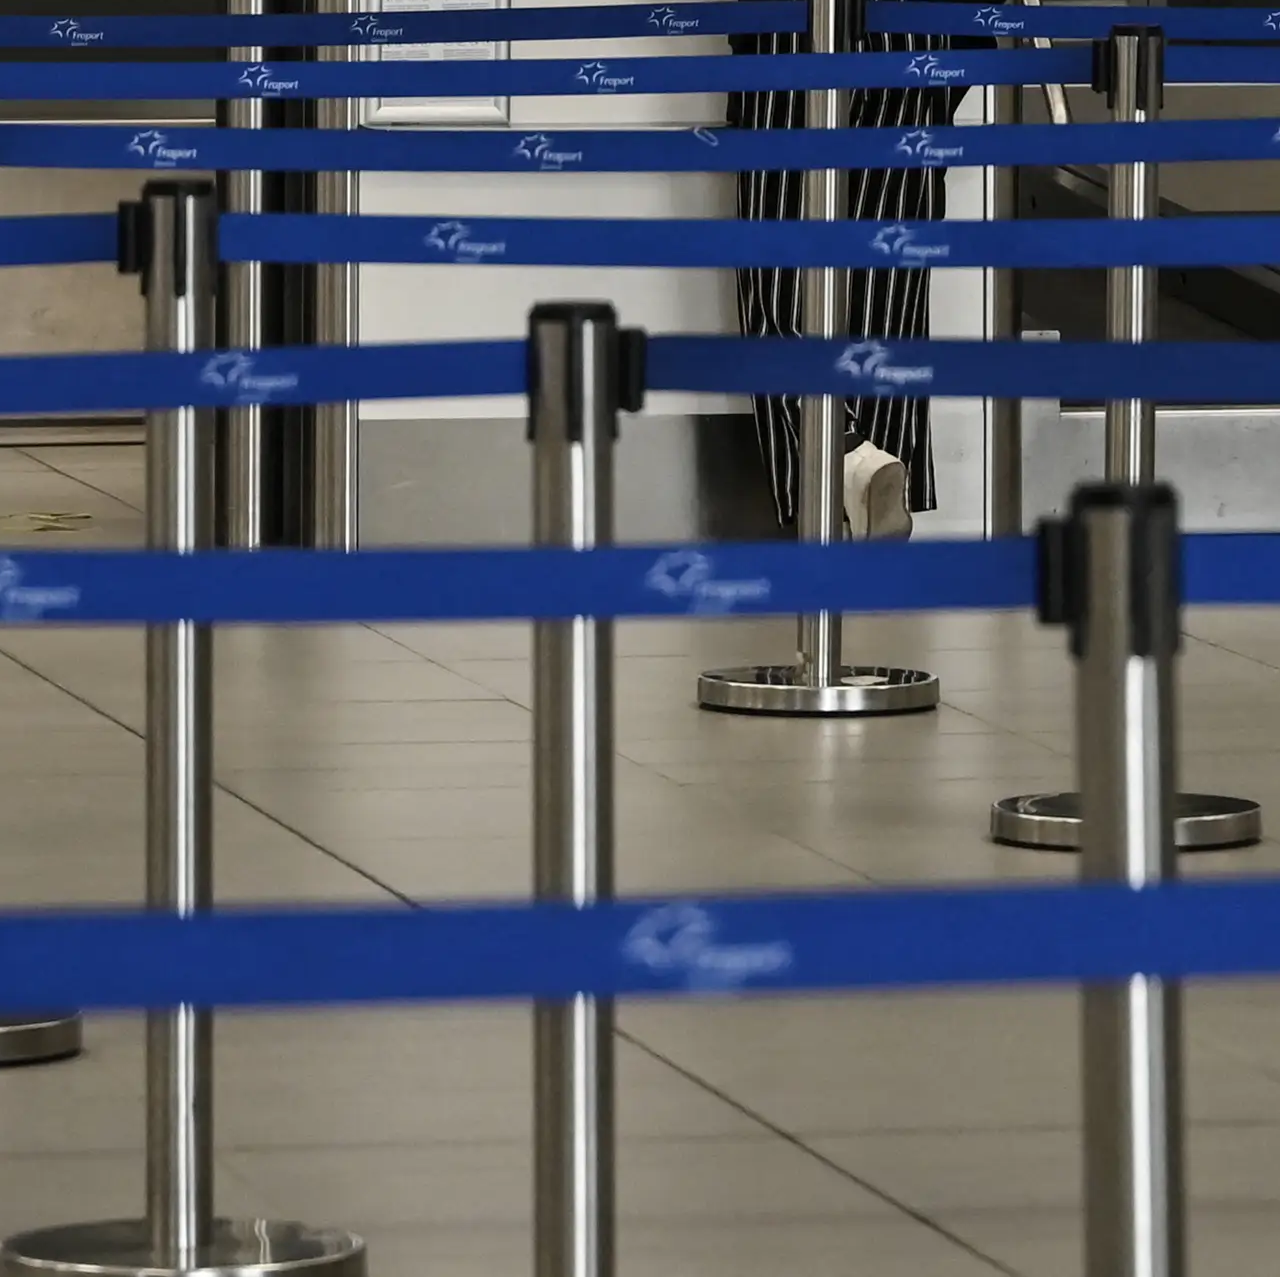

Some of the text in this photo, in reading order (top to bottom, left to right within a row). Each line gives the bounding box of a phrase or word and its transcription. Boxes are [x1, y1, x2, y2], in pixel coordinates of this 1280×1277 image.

[668, 19, 699, 29] Fraport
[994, 21, 1024, 31] Fraport
[72, 31, 104, 41] Fraport
[372, 27, 403, 39] Fraport
[930, 68, 964, 80] Fraport
[264, 80, 298, 91] Fraport
[600, 76, 634, 87] Fraport
